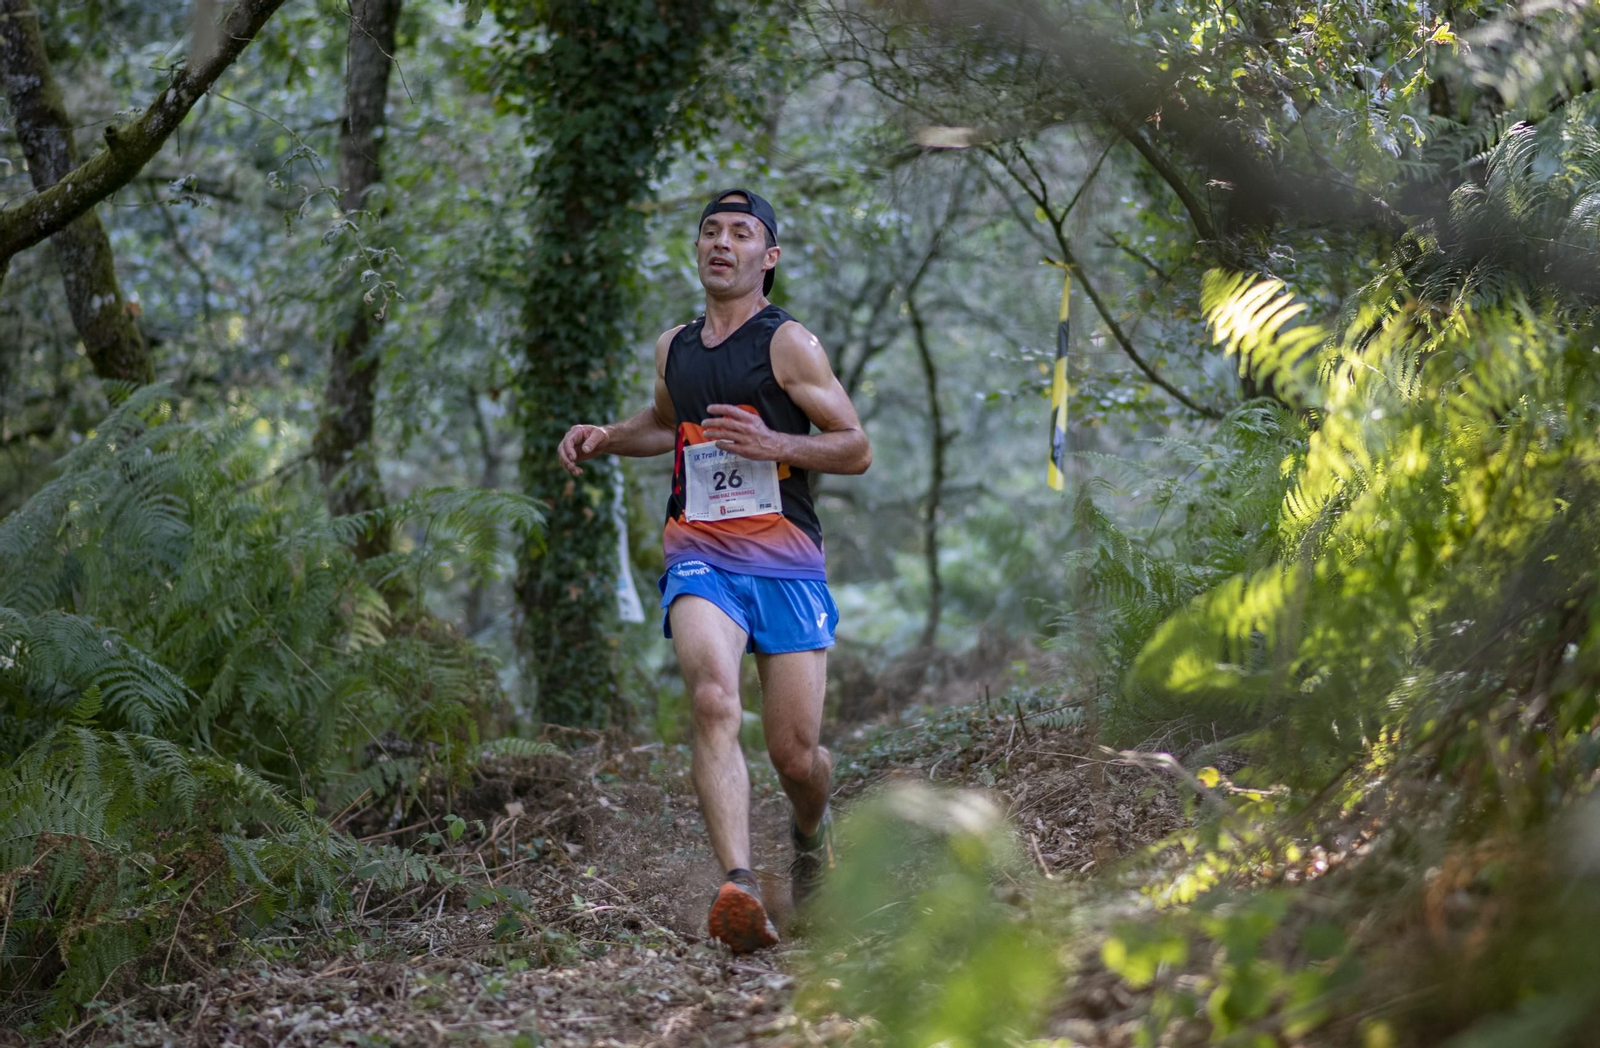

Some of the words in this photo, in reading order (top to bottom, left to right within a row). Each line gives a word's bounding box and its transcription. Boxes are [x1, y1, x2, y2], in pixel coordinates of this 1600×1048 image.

[694, 453, 700, 461] IX
[701, 450, 717, 459] Trail
[713, 469, 743, 491] 26
